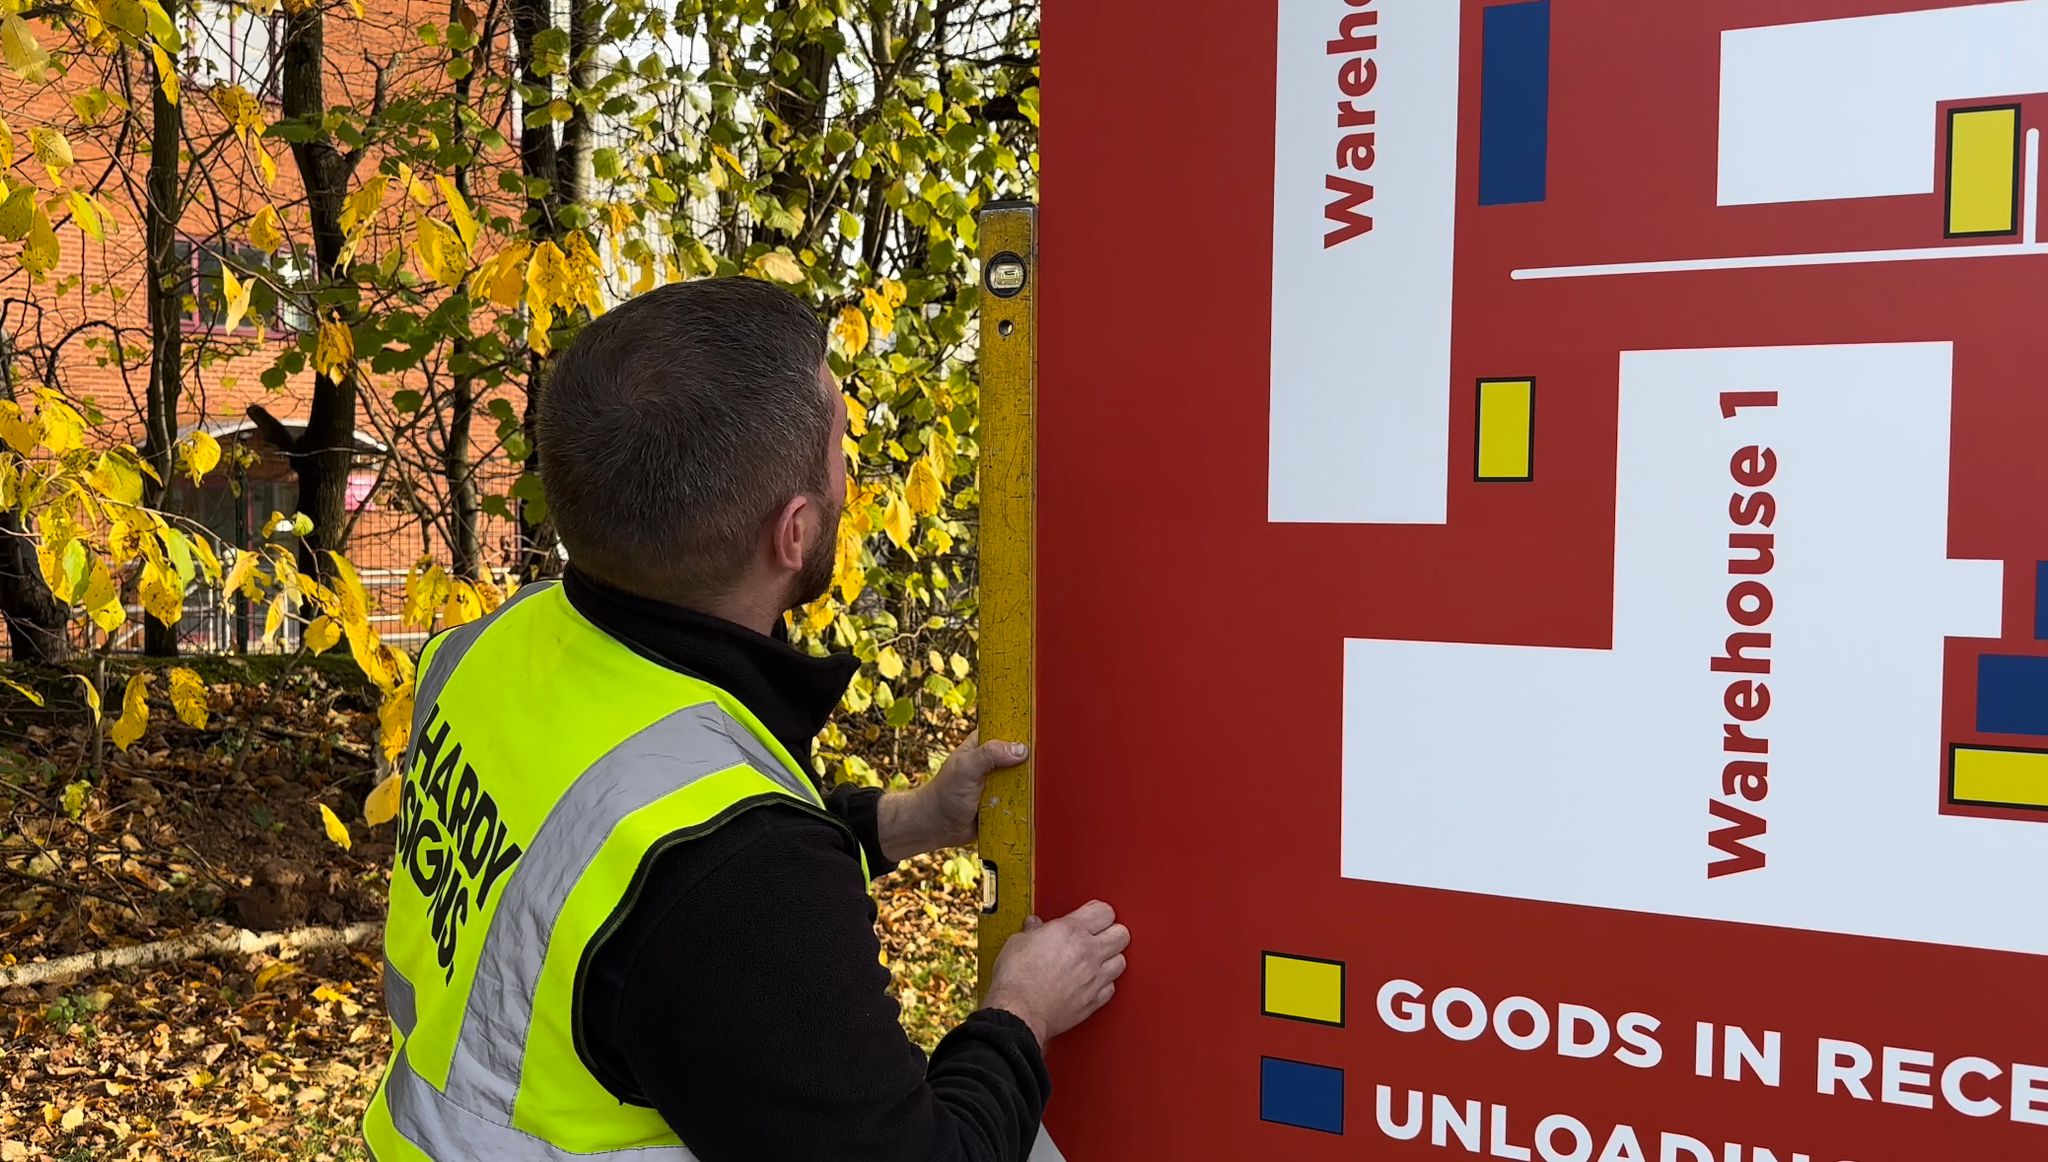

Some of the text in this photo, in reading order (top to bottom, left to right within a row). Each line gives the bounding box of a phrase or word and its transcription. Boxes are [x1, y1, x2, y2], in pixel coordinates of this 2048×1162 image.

[1323, 0, 1378, 250] Wareh
[1707, 390, 1779, 880] Warehouse 1
[399, 780, 469, 987] SIGNS.
[411, 702, 523, 912] HARDY
[1376, 979, 2048, 1126] GOODS IN RECE
[1376, 1084, 1865, 1162] UNLOAD
